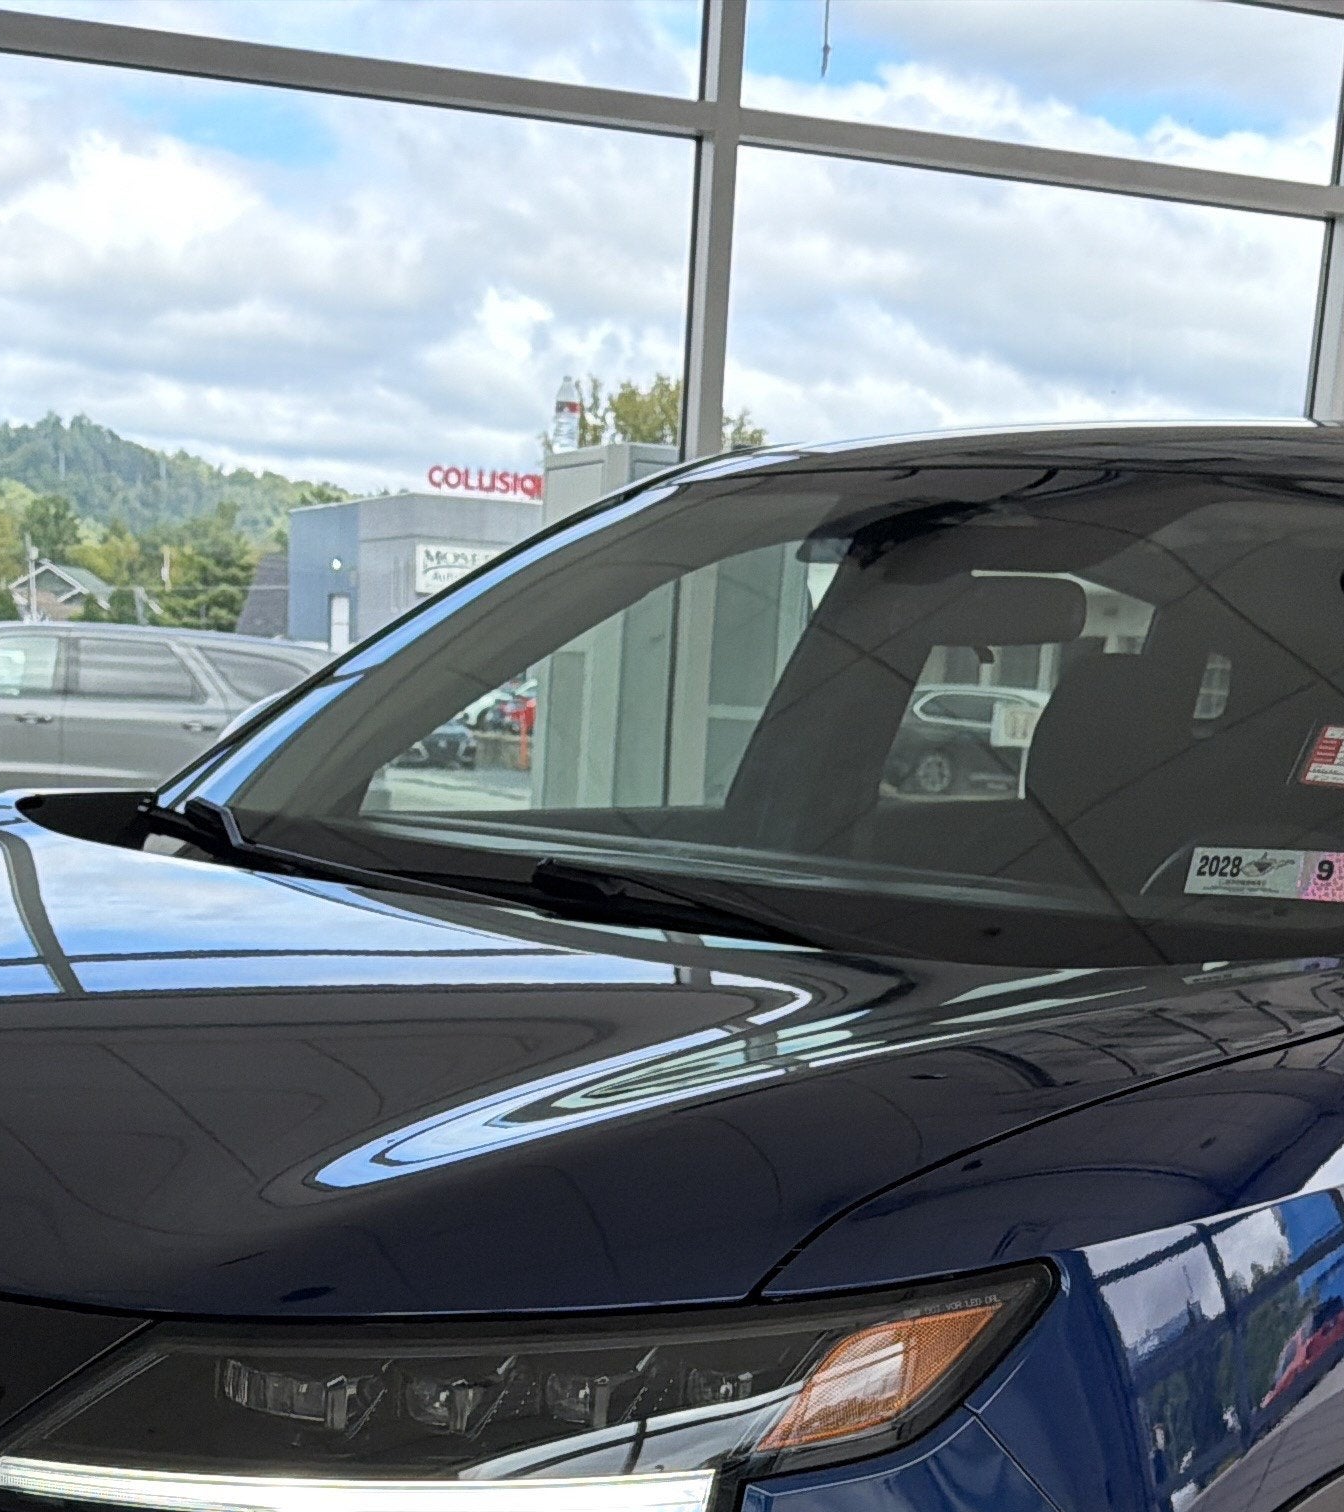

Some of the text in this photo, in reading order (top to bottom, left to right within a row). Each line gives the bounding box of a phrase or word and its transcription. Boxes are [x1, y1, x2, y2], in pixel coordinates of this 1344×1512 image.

[428, 465, 543, 499] COLLISIO
[1196, 855, 1335, 881] 2028 9
